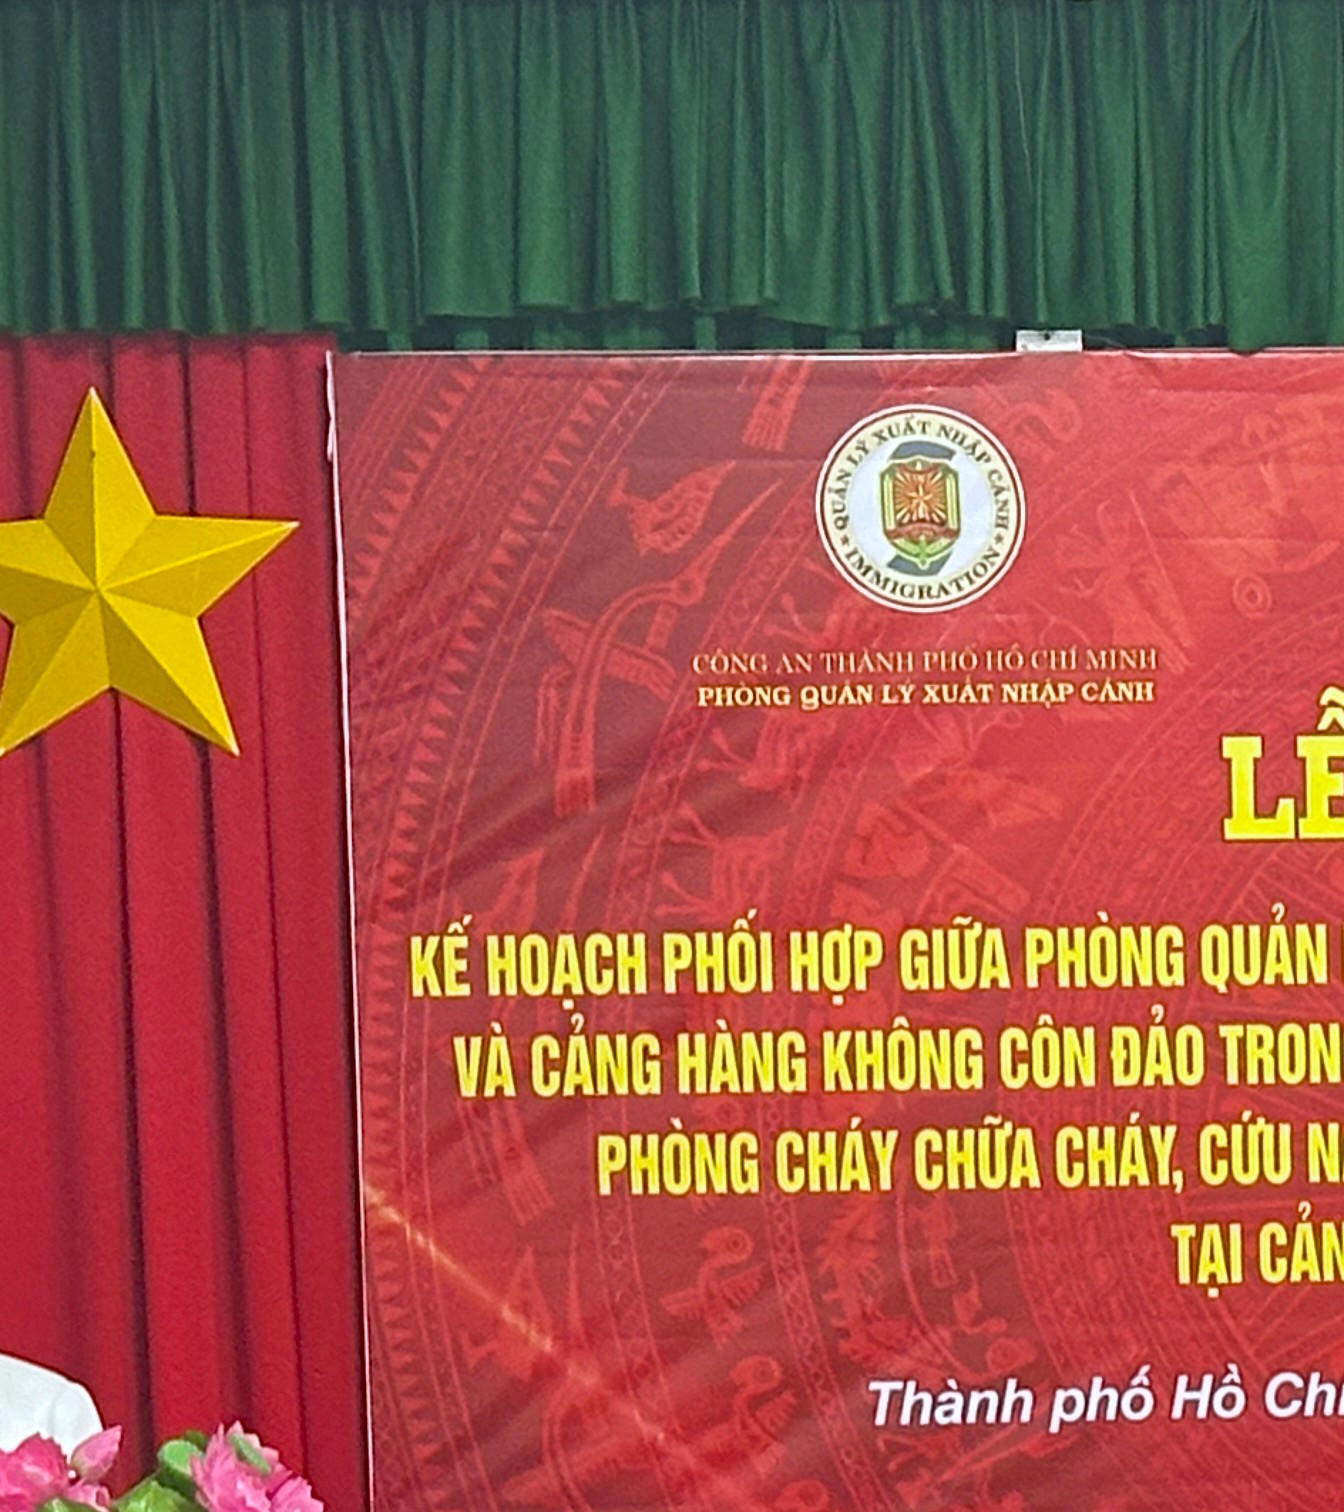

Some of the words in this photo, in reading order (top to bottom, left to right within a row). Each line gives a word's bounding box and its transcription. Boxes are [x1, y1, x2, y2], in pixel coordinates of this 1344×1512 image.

[845, 546, 1001, 600] IMMIGRATION
[697, 681, 792, 706] PHÒNG
[800, 678, 874, 711] QUẢN
[881, 678, 915, 706] LÝ
[923, 674, 993, 704] XUẤT
[1001, 680, 1073, 709] NHẬP
[1081, 677, 1155, 703] CẢNH
[410, 914, 473, 998] KẾ
[486, 932, 647, 1010] HOẠCH
[662, 908, 774, 994] PHỐI
[789, 923, 883, 1006] HỢP
[899, 916, 1011, 991] GIỮA
[1024, 910, 1185, 989] PHÒNG
[1200, 902, 1328, 994] QUẢN
[453, 1021, 517, 1098] VÀ
[531, 1012, 662, 1098] CẢNG
[677, 1018, 807, 1095] HÀNG
[822, 1015, 984, 1092] KHÔNG
[999, 1013, 1096, 1090] CÔN
[1110, 1003, 1205, 1087] ĐẢO
[597, 1117, 760, 1196] PHÒNG
[775, 1116, 899, 1194] CHÁY
[914, 1115, 1041, 1191] CHỮA
[1055, 1111, 1184, 1194] CHÁY,
[1199, 1109, 1292, 1186] CỨU
[1170, 1223, 1243, 1298] TẠI
[868, 1378, 1033, 1426] Thành
[1049, 1364, 1154, 1434] phố
[1171, 1363, 1246, 1419] Hồ
